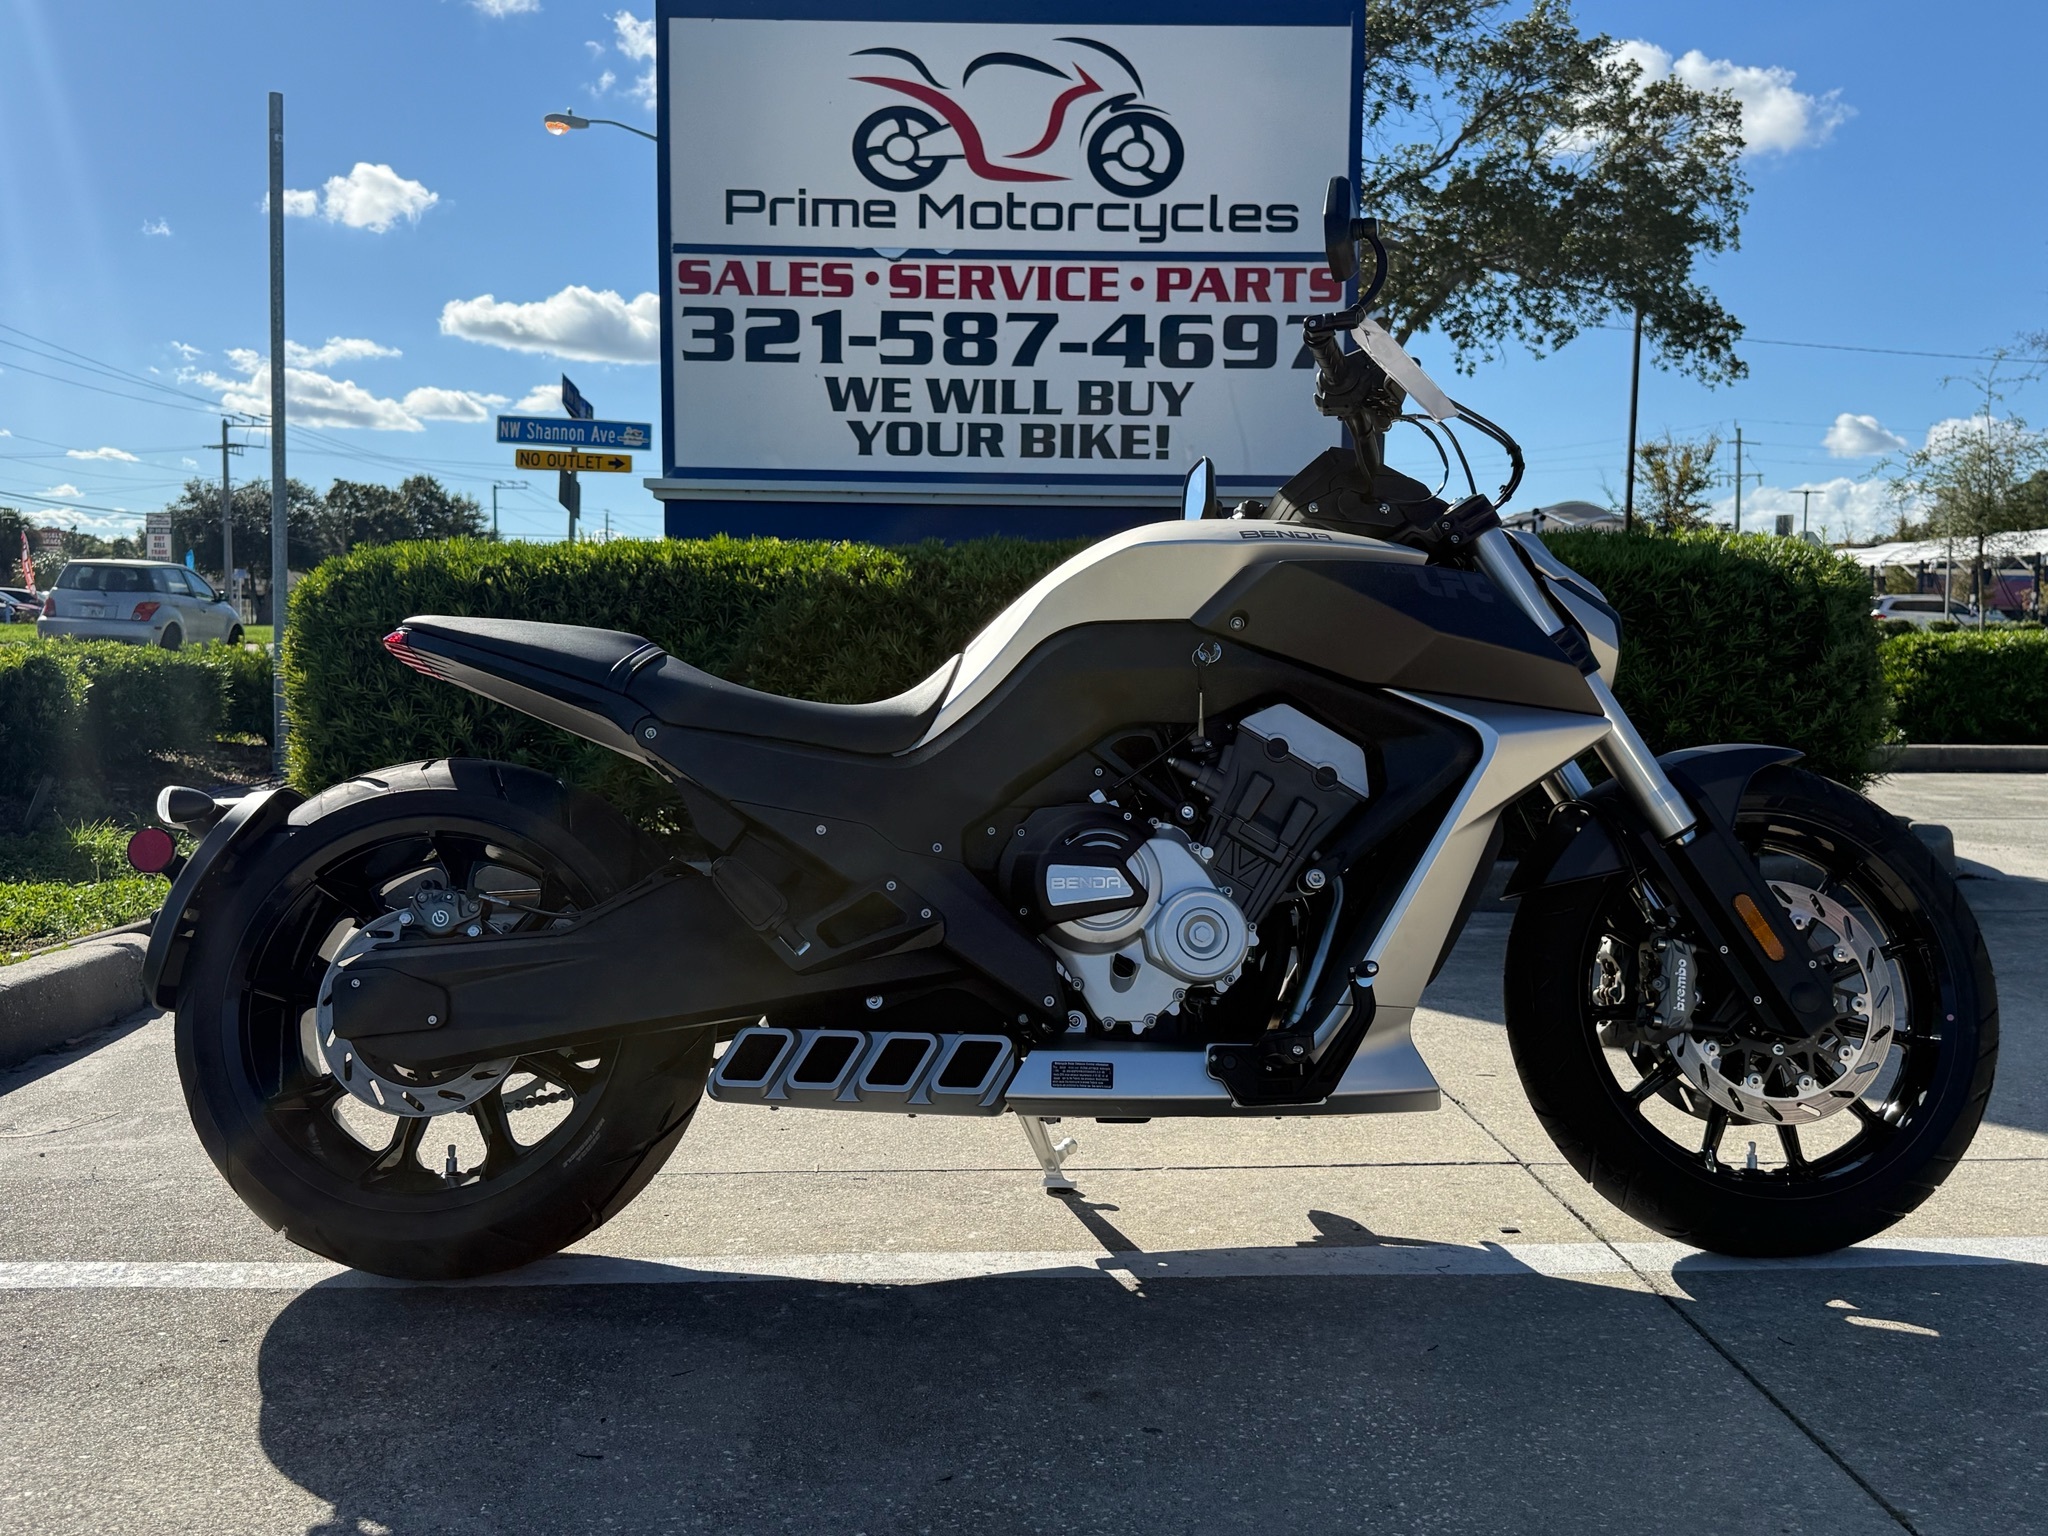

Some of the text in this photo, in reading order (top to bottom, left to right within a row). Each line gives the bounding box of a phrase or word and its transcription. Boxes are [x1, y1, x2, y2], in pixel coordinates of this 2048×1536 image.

[725, 188, 1299, 244] Prime Motorcycles
[678, 259, 1342, 303] SALES SERVICE PARTS
[824, 376, 1195, 417] WE WILL BUY
[500, 421, 616, 443] NW Shannon Ave
[846, 420, 1170, 460] YOUR BIKE!
[519, 452, 604, 469] NO OUTLET
[1239, 529, 1334, 541] BENDA
[1051, 876, 1122, 889] BENDA
[1672, 958, 1687, 1012] brembo
